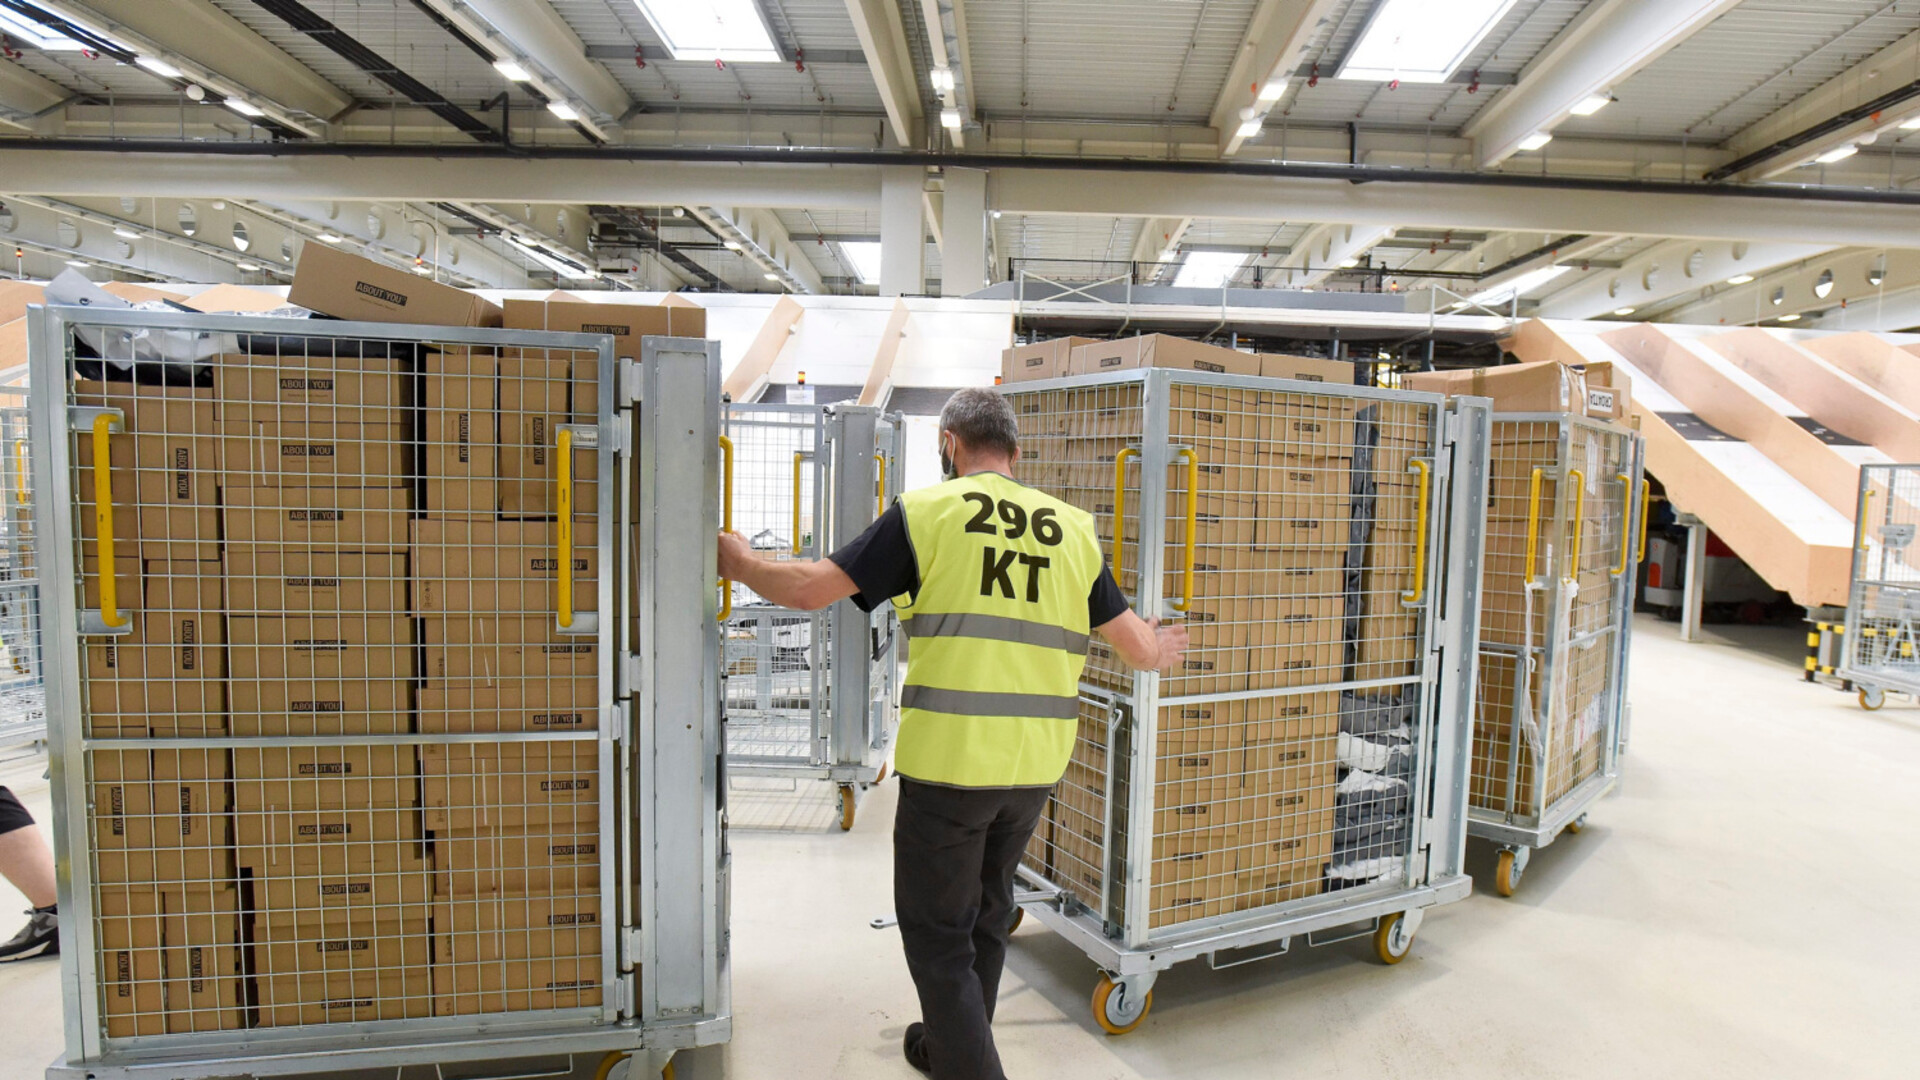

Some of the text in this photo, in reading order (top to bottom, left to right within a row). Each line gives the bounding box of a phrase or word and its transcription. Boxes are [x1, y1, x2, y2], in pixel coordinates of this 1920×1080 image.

[357, 282, 384, 298] ABOUT
[384, 292, 402, 304] YOU
[583, 325, 626, 335] ABOUT YOU
[281, 379, 329, 390] ABOU YOU
[283, 445, 330, 456] ABOU YOU
[291, 511, 319, 520] ABOUT
[962, 492, 1063, 546] 296
[980, 546, 1050, 603] KT
[323, 701, 340, 711] YOU
[549, 846, 573, 855] BOUT
[574, 914, 590, 923] OU
[347, 941, 362, 950] OU
[119, 971, 129, 996] ABUT
[192, 967, 202, 993] ABUT
